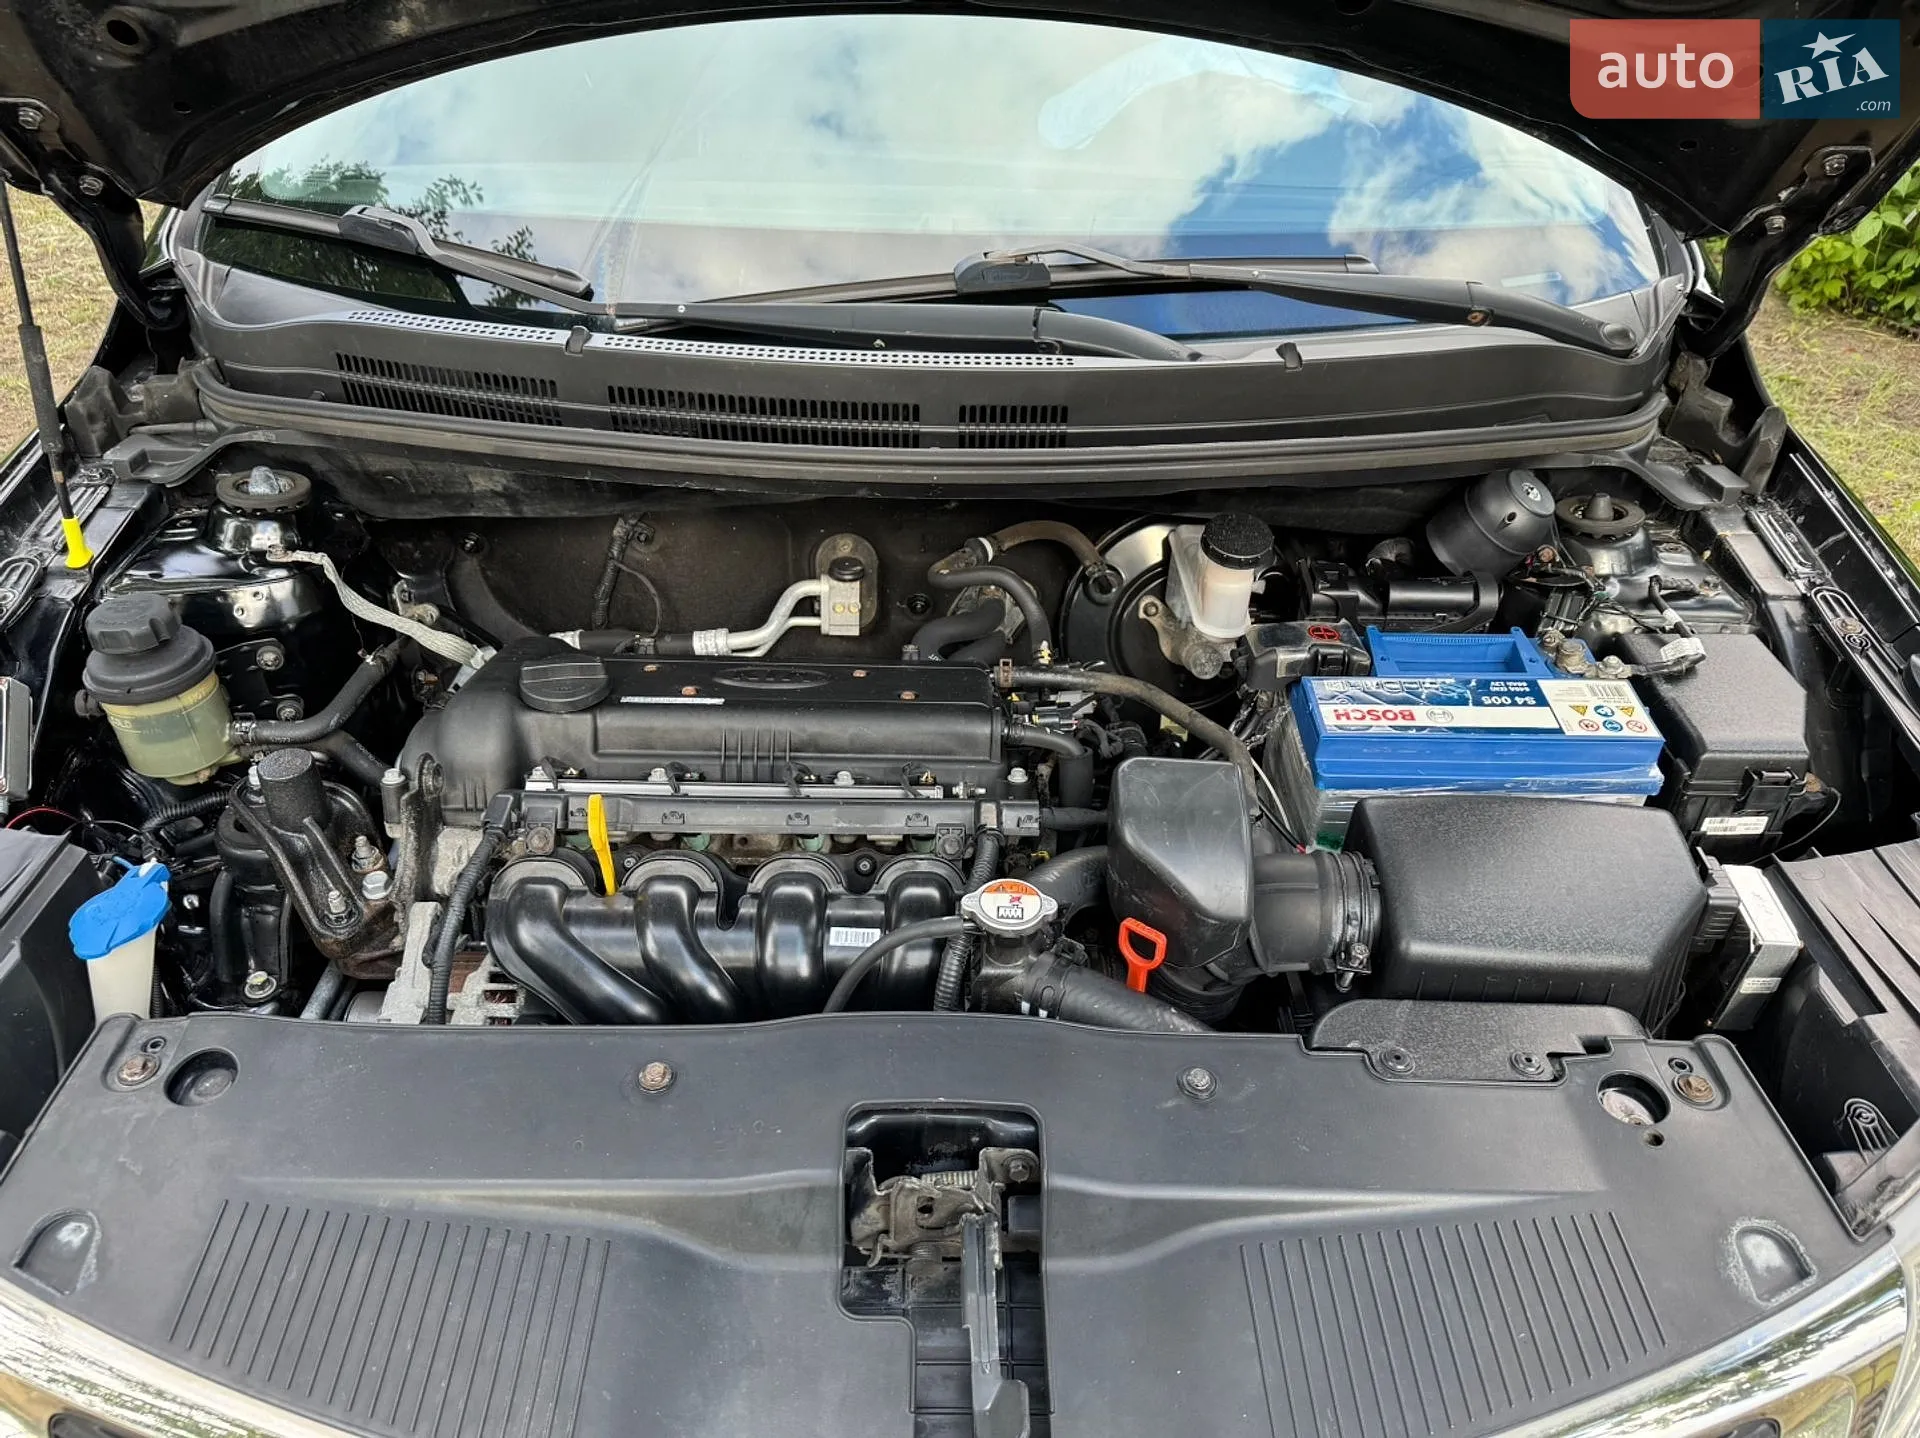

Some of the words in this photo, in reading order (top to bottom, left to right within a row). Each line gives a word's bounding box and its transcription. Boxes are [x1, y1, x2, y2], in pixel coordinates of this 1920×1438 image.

[1481, 695, 1512, 706] 005
[1515, 695, 1537, 706] S4
[1333, 707, 1416, 722] BOSCH
